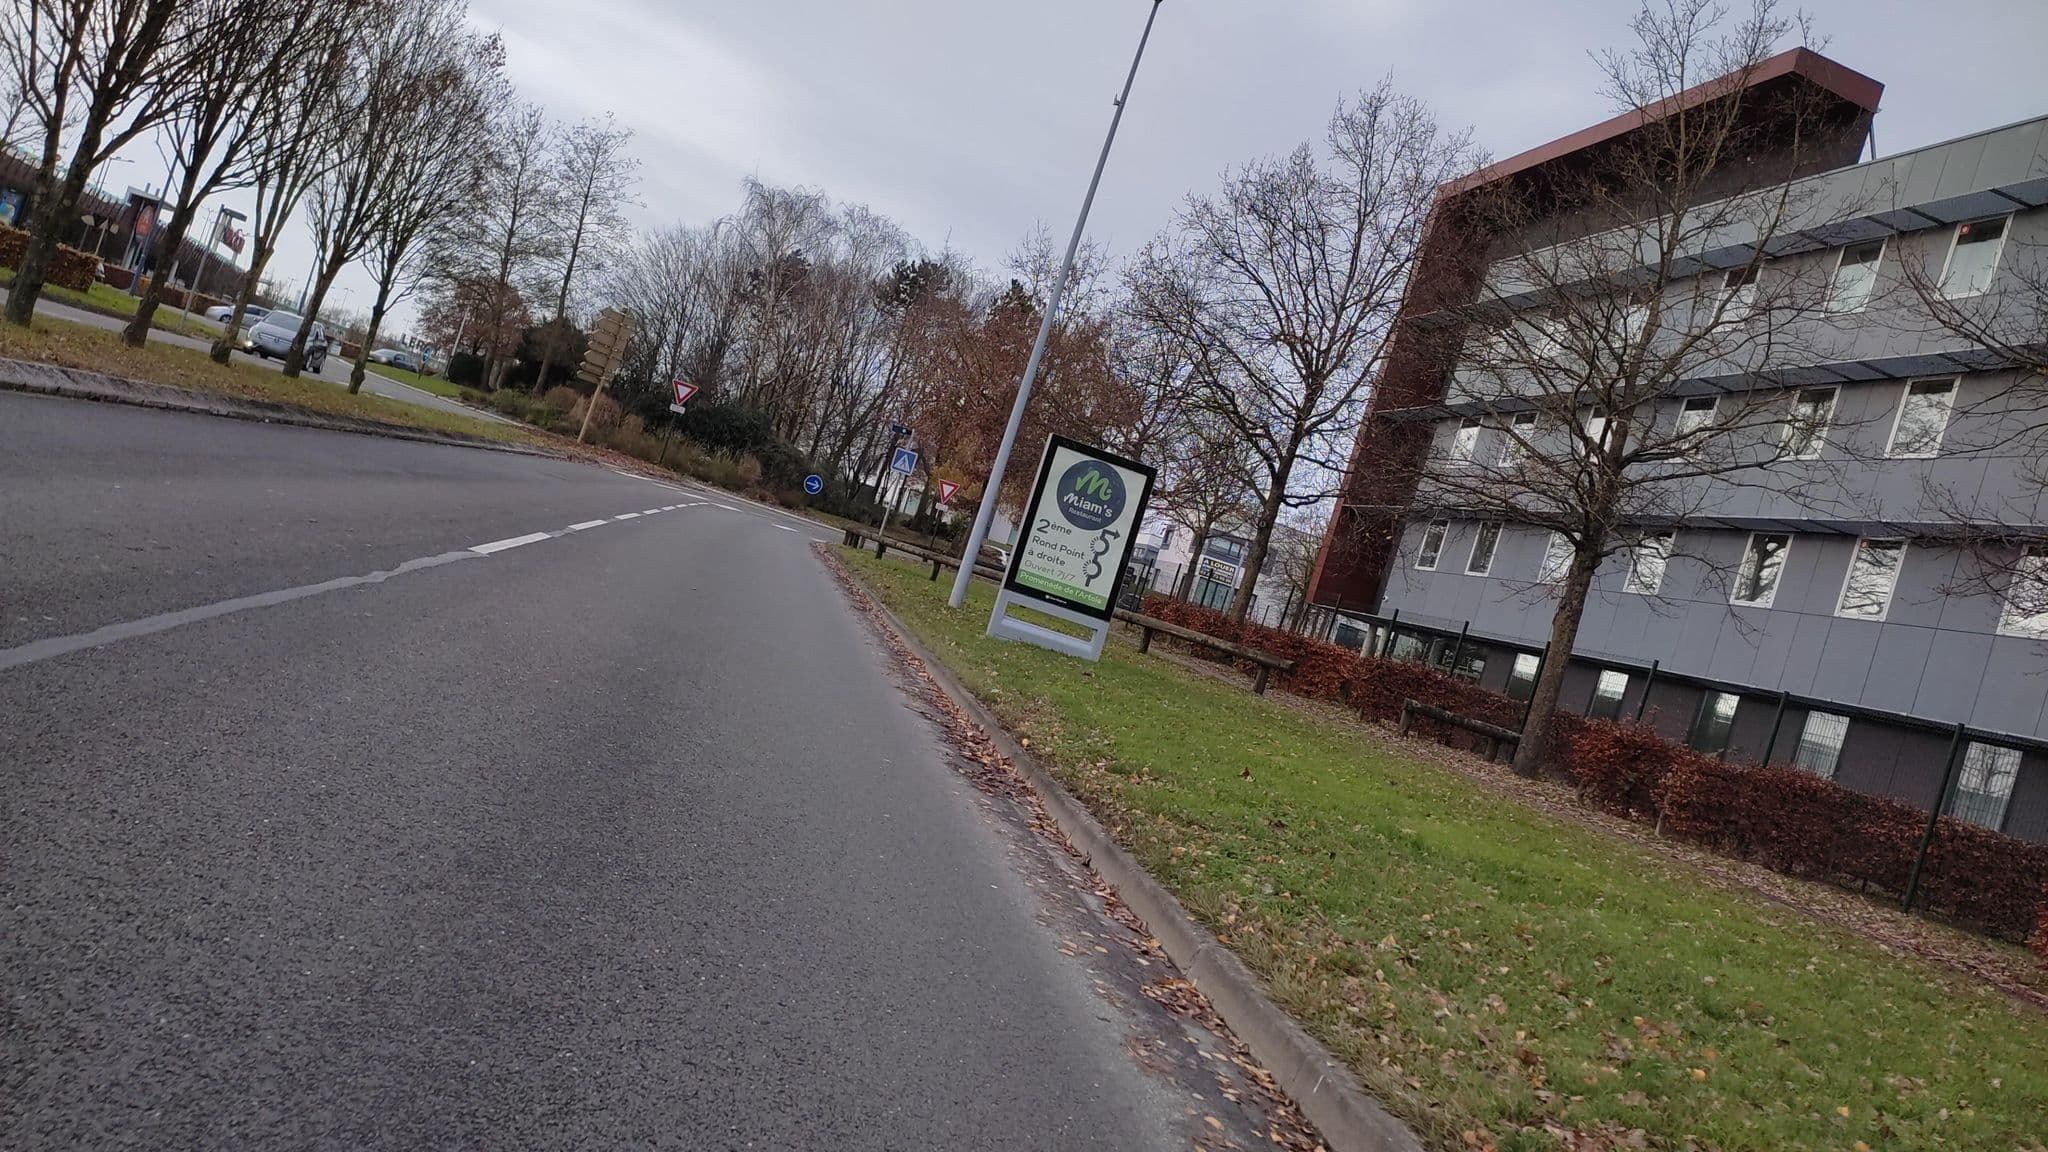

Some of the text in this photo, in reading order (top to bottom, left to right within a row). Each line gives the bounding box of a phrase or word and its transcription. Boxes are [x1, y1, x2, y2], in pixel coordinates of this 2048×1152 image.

[1063, 493, 1113, 518] Miam's
[1032, 535, 1085, 560] Rond Point
[1024, 559, 1055, 575] Ouvert
[1036, 552, 1066, 567] droite
[1019, 571, 1063, 591] Promenade
[1063, 586, 1074, 594] de
